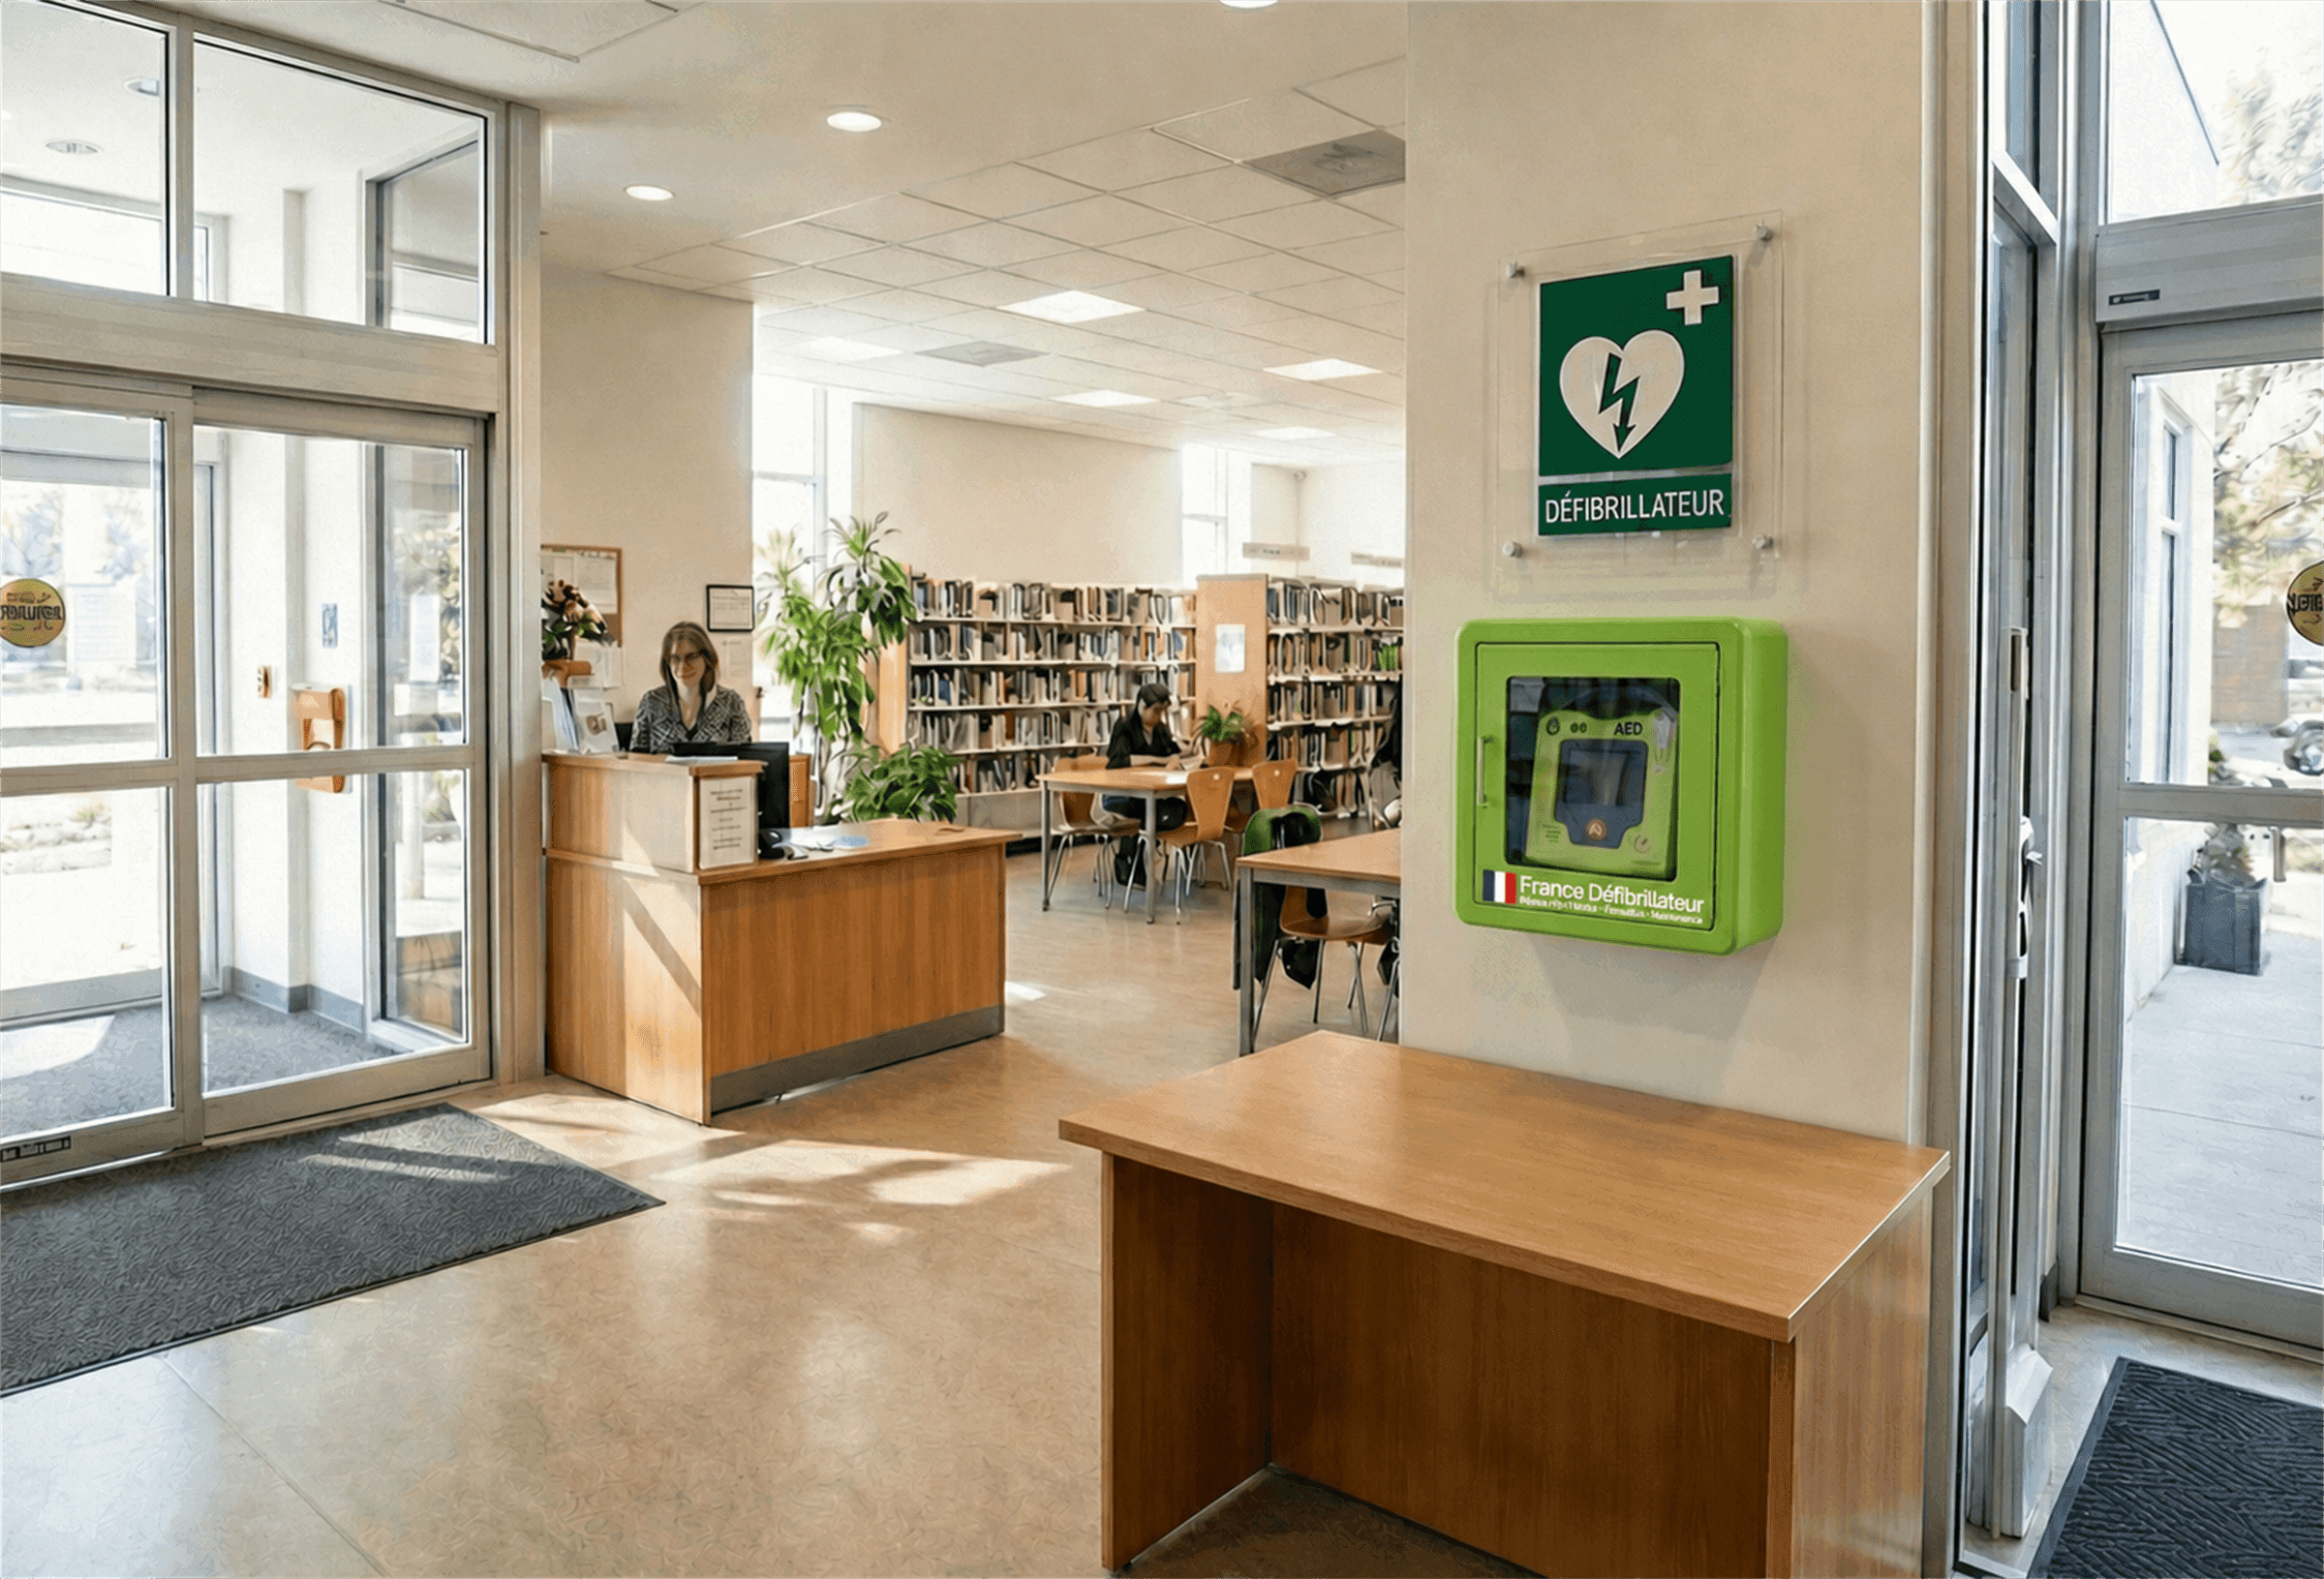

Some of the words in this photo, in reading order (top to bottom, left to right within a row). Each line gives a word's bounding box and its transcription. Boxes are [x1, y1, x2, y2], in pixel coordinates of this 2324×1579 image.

[1545, 489, 1725, 523] DÉFIBRILLATEUR
[1614, 721, 1643, 736] AED
[1520, 875, 1584, 900] France
[1589, 883, 1704, 913] Défibrillateur
